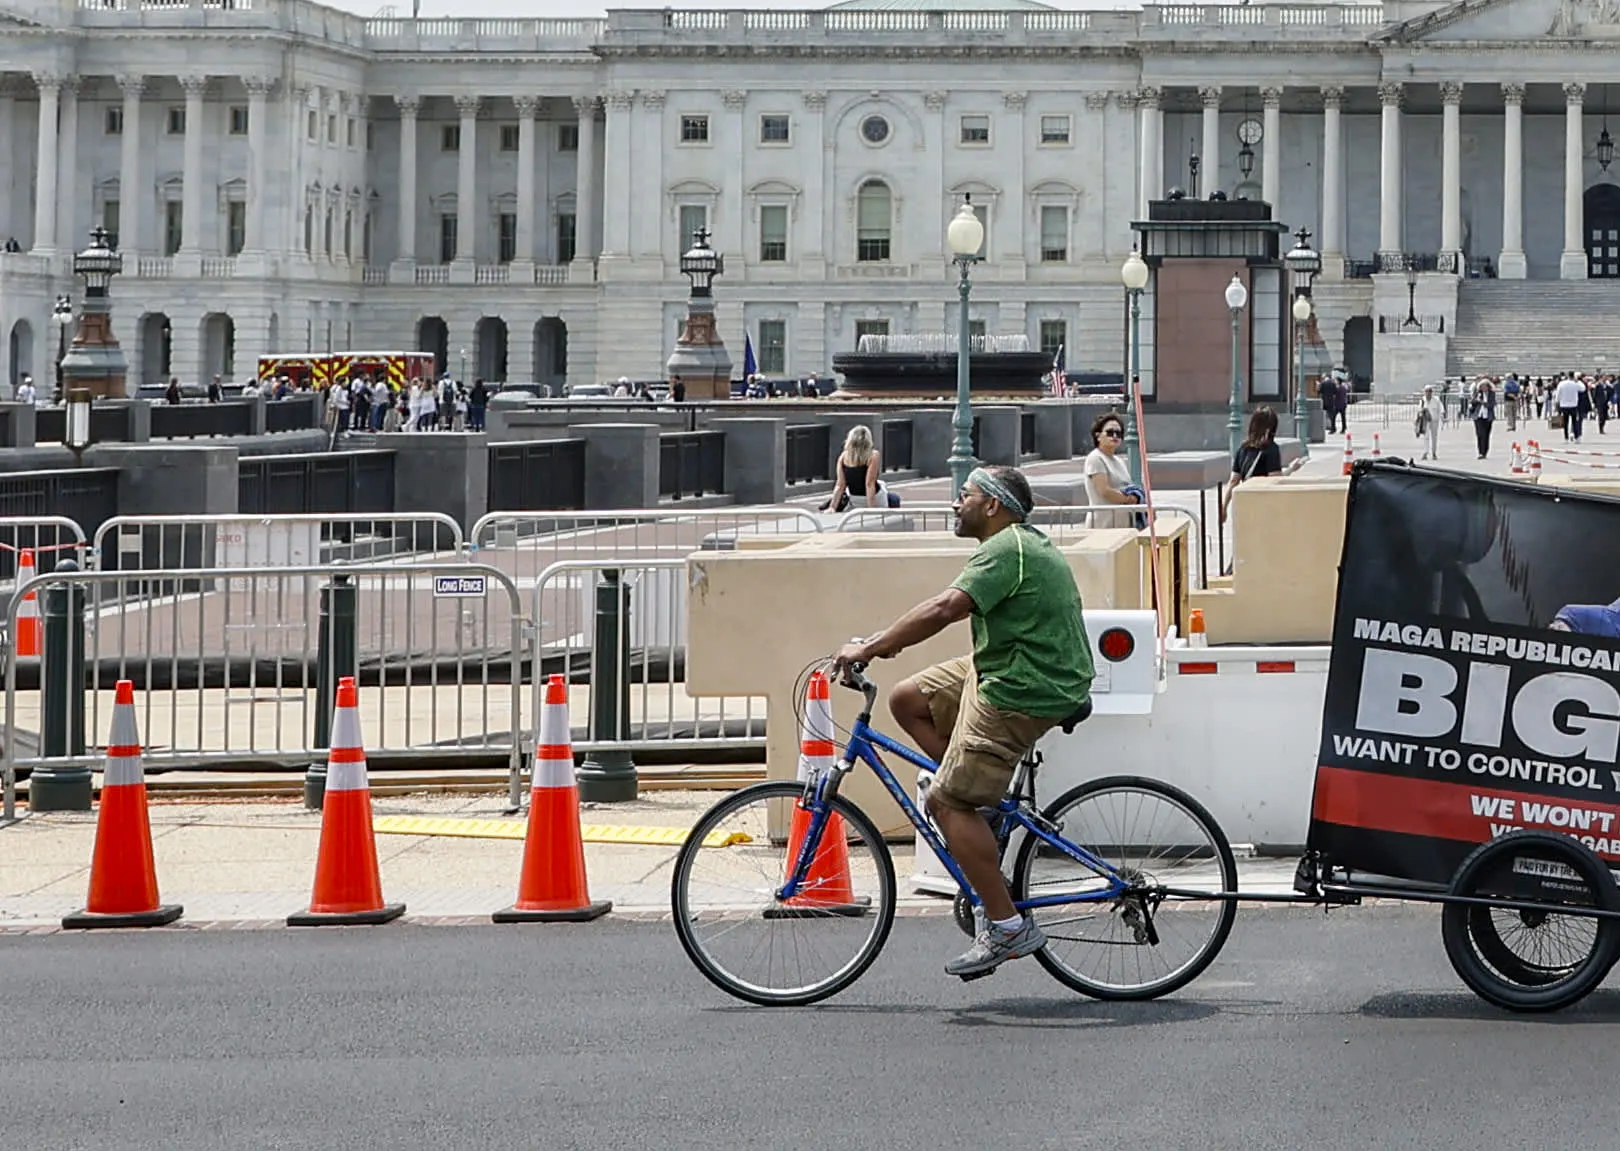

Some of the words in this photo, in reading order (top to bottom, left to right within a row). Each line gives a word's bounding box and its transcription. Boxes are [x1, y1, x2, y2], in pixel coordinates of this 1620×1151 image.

[437, 579, 457, 592] LONG
[459, 579, 482, 592] FENCE
[1353, 618, 1444, 649] MAGA
[1332, 734, 1418, 766] WANT
[1424, 746, 1461, 770] TO
[1467, 752, 1603, 790] CONTROL
[1470, 794, 1516, 820] WE
[1521, 800, 1615, 832] WON’T
